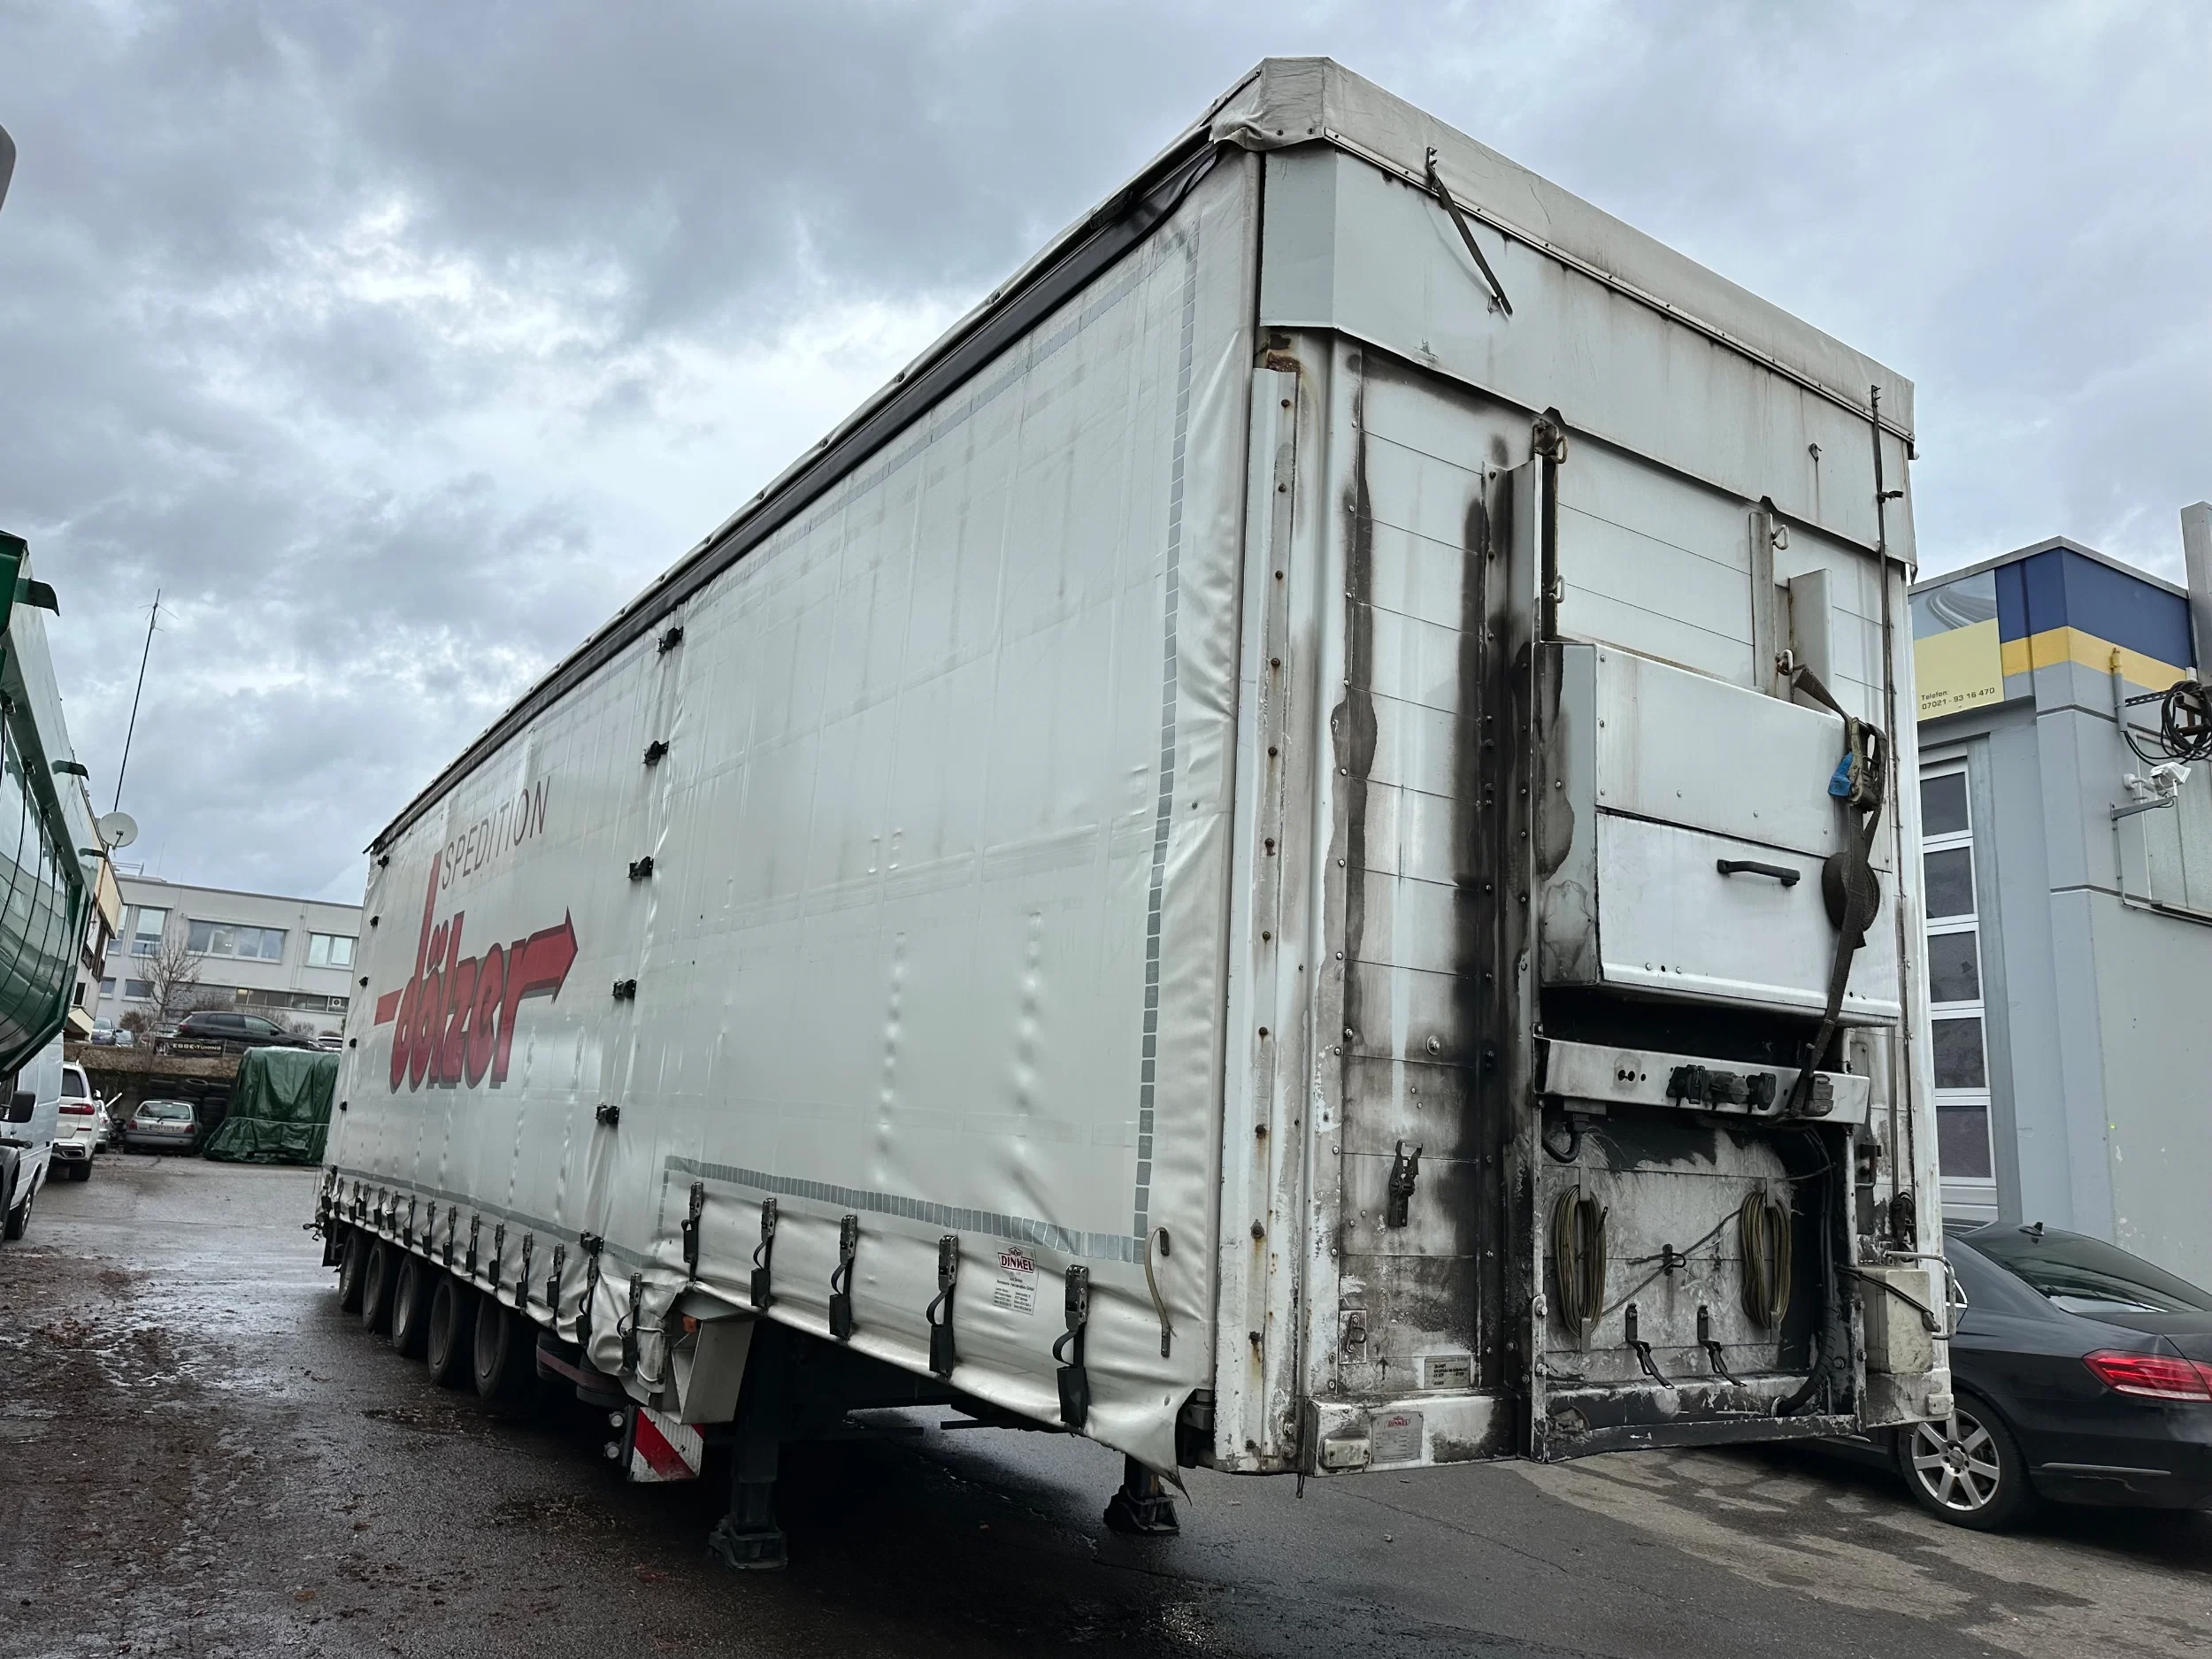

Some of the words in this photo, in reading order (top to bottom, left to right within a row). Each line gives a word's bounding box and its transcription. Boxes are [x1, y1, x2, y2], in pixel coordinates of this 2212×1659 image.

[1922, 698, 1947, 710] 07021
[1978, 687, 1995, 696] 470
[442, 775, 551, 891] SPEDITION
[1001, 1255, 1033, 1271] DINKEL
